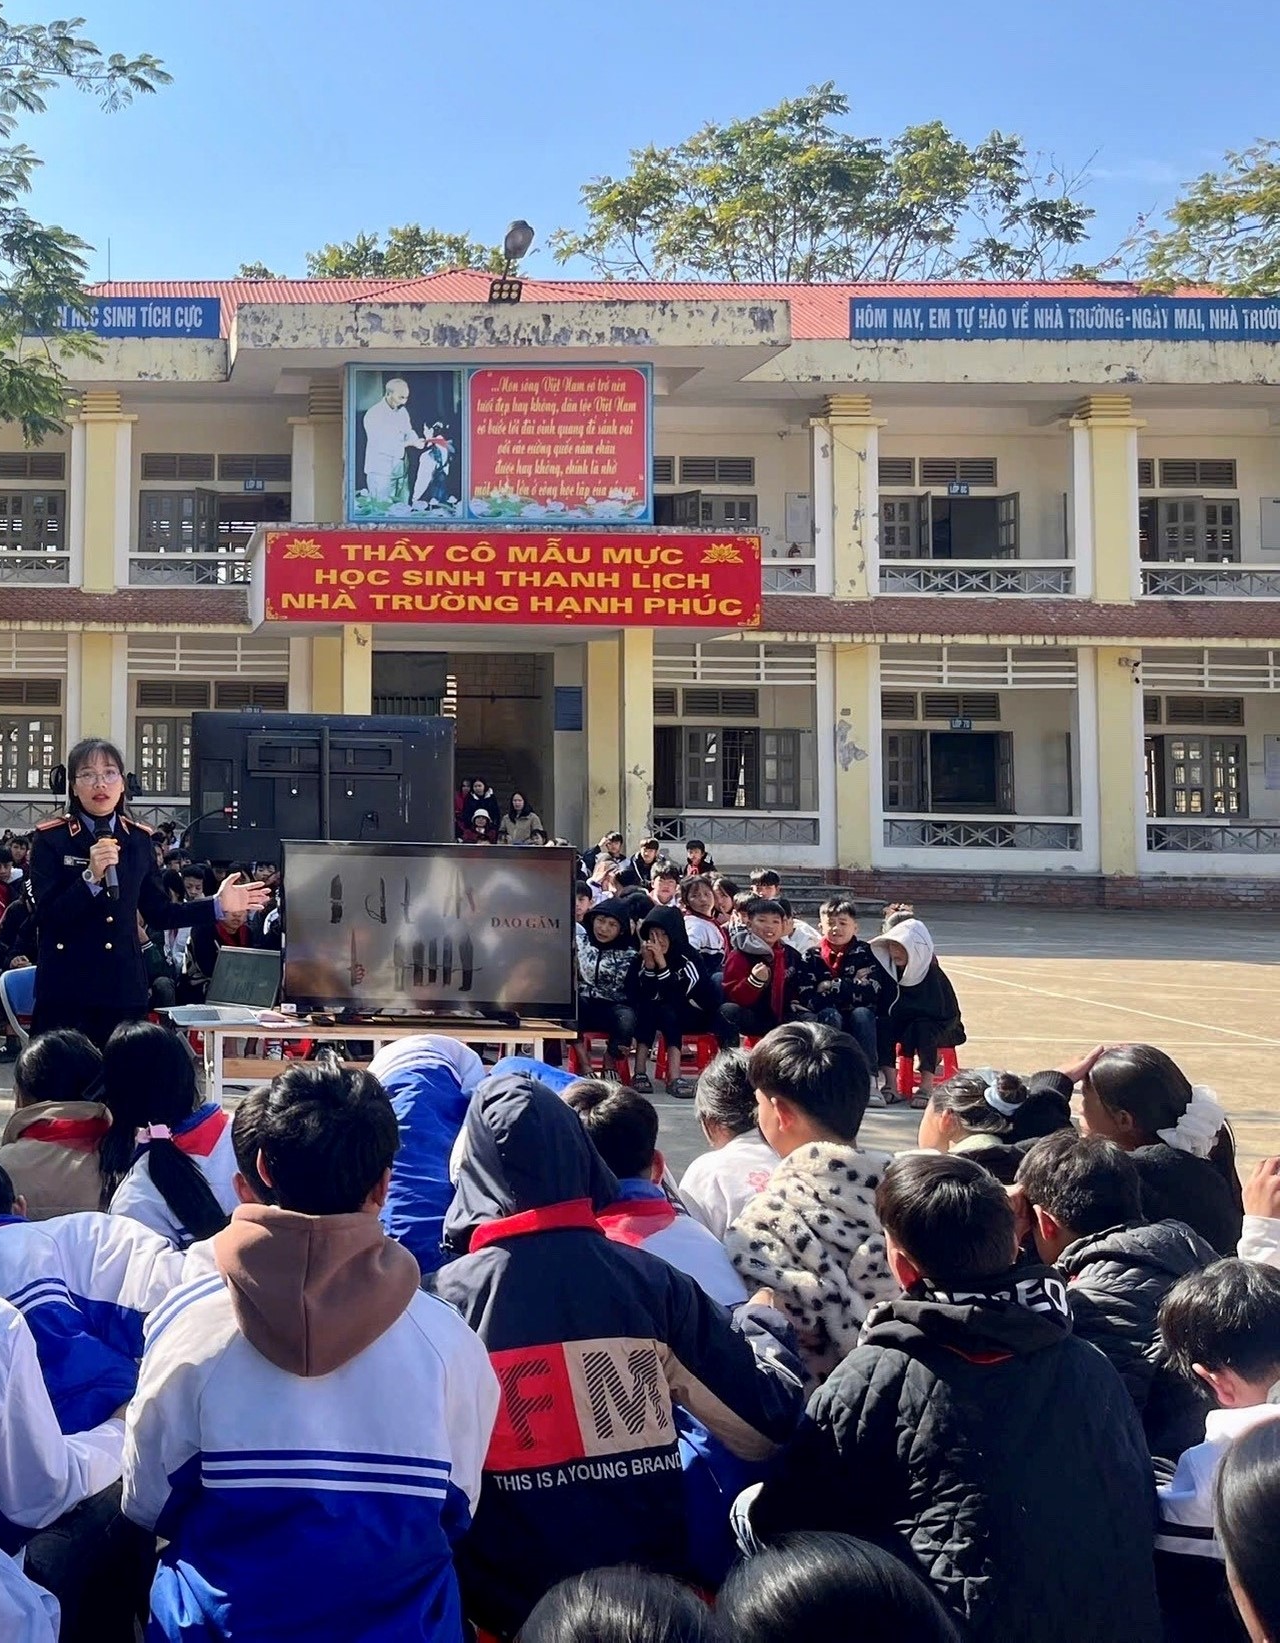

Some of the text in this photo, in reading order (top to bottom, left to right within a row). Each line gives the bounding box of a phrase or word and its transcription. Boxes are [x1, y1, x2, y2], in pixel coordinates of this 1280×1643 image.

[103, 306, 136, 328] SINH
[140, 302, 171, 328] TÍCH
[175, 305, 202, 332] CỰC
[855, 304, 887, 328] HÔM
[893, 308, 924, 331] NAY,
[929, 308, 950, 328] EM
[956, 306, 975, 333] TỰ
[978, 304, 1006, 328] HÀO
[1012, 301, 1030, 328] VỀ
[1034, 304, 1064, 328] NHÀ
[1174, 308, 1205, 332] MAI,
[1210, 304, 1238, 329] NHÀ
[1242, 304, 1280, 330] TRƯỜ
[341, 538, 684, 568] THẦY CÔ MẪU MỰC
[316, 569, 710, 592] HỌC SINH THANH LỊCH
[281, 589, 742, 619] NHÀ TRƯỜNG HẠNH PHÚC
[491, 917, 522, 928] DAO
[494, 1452, 682, 1491] THIS IS A YOUNG BRAND
